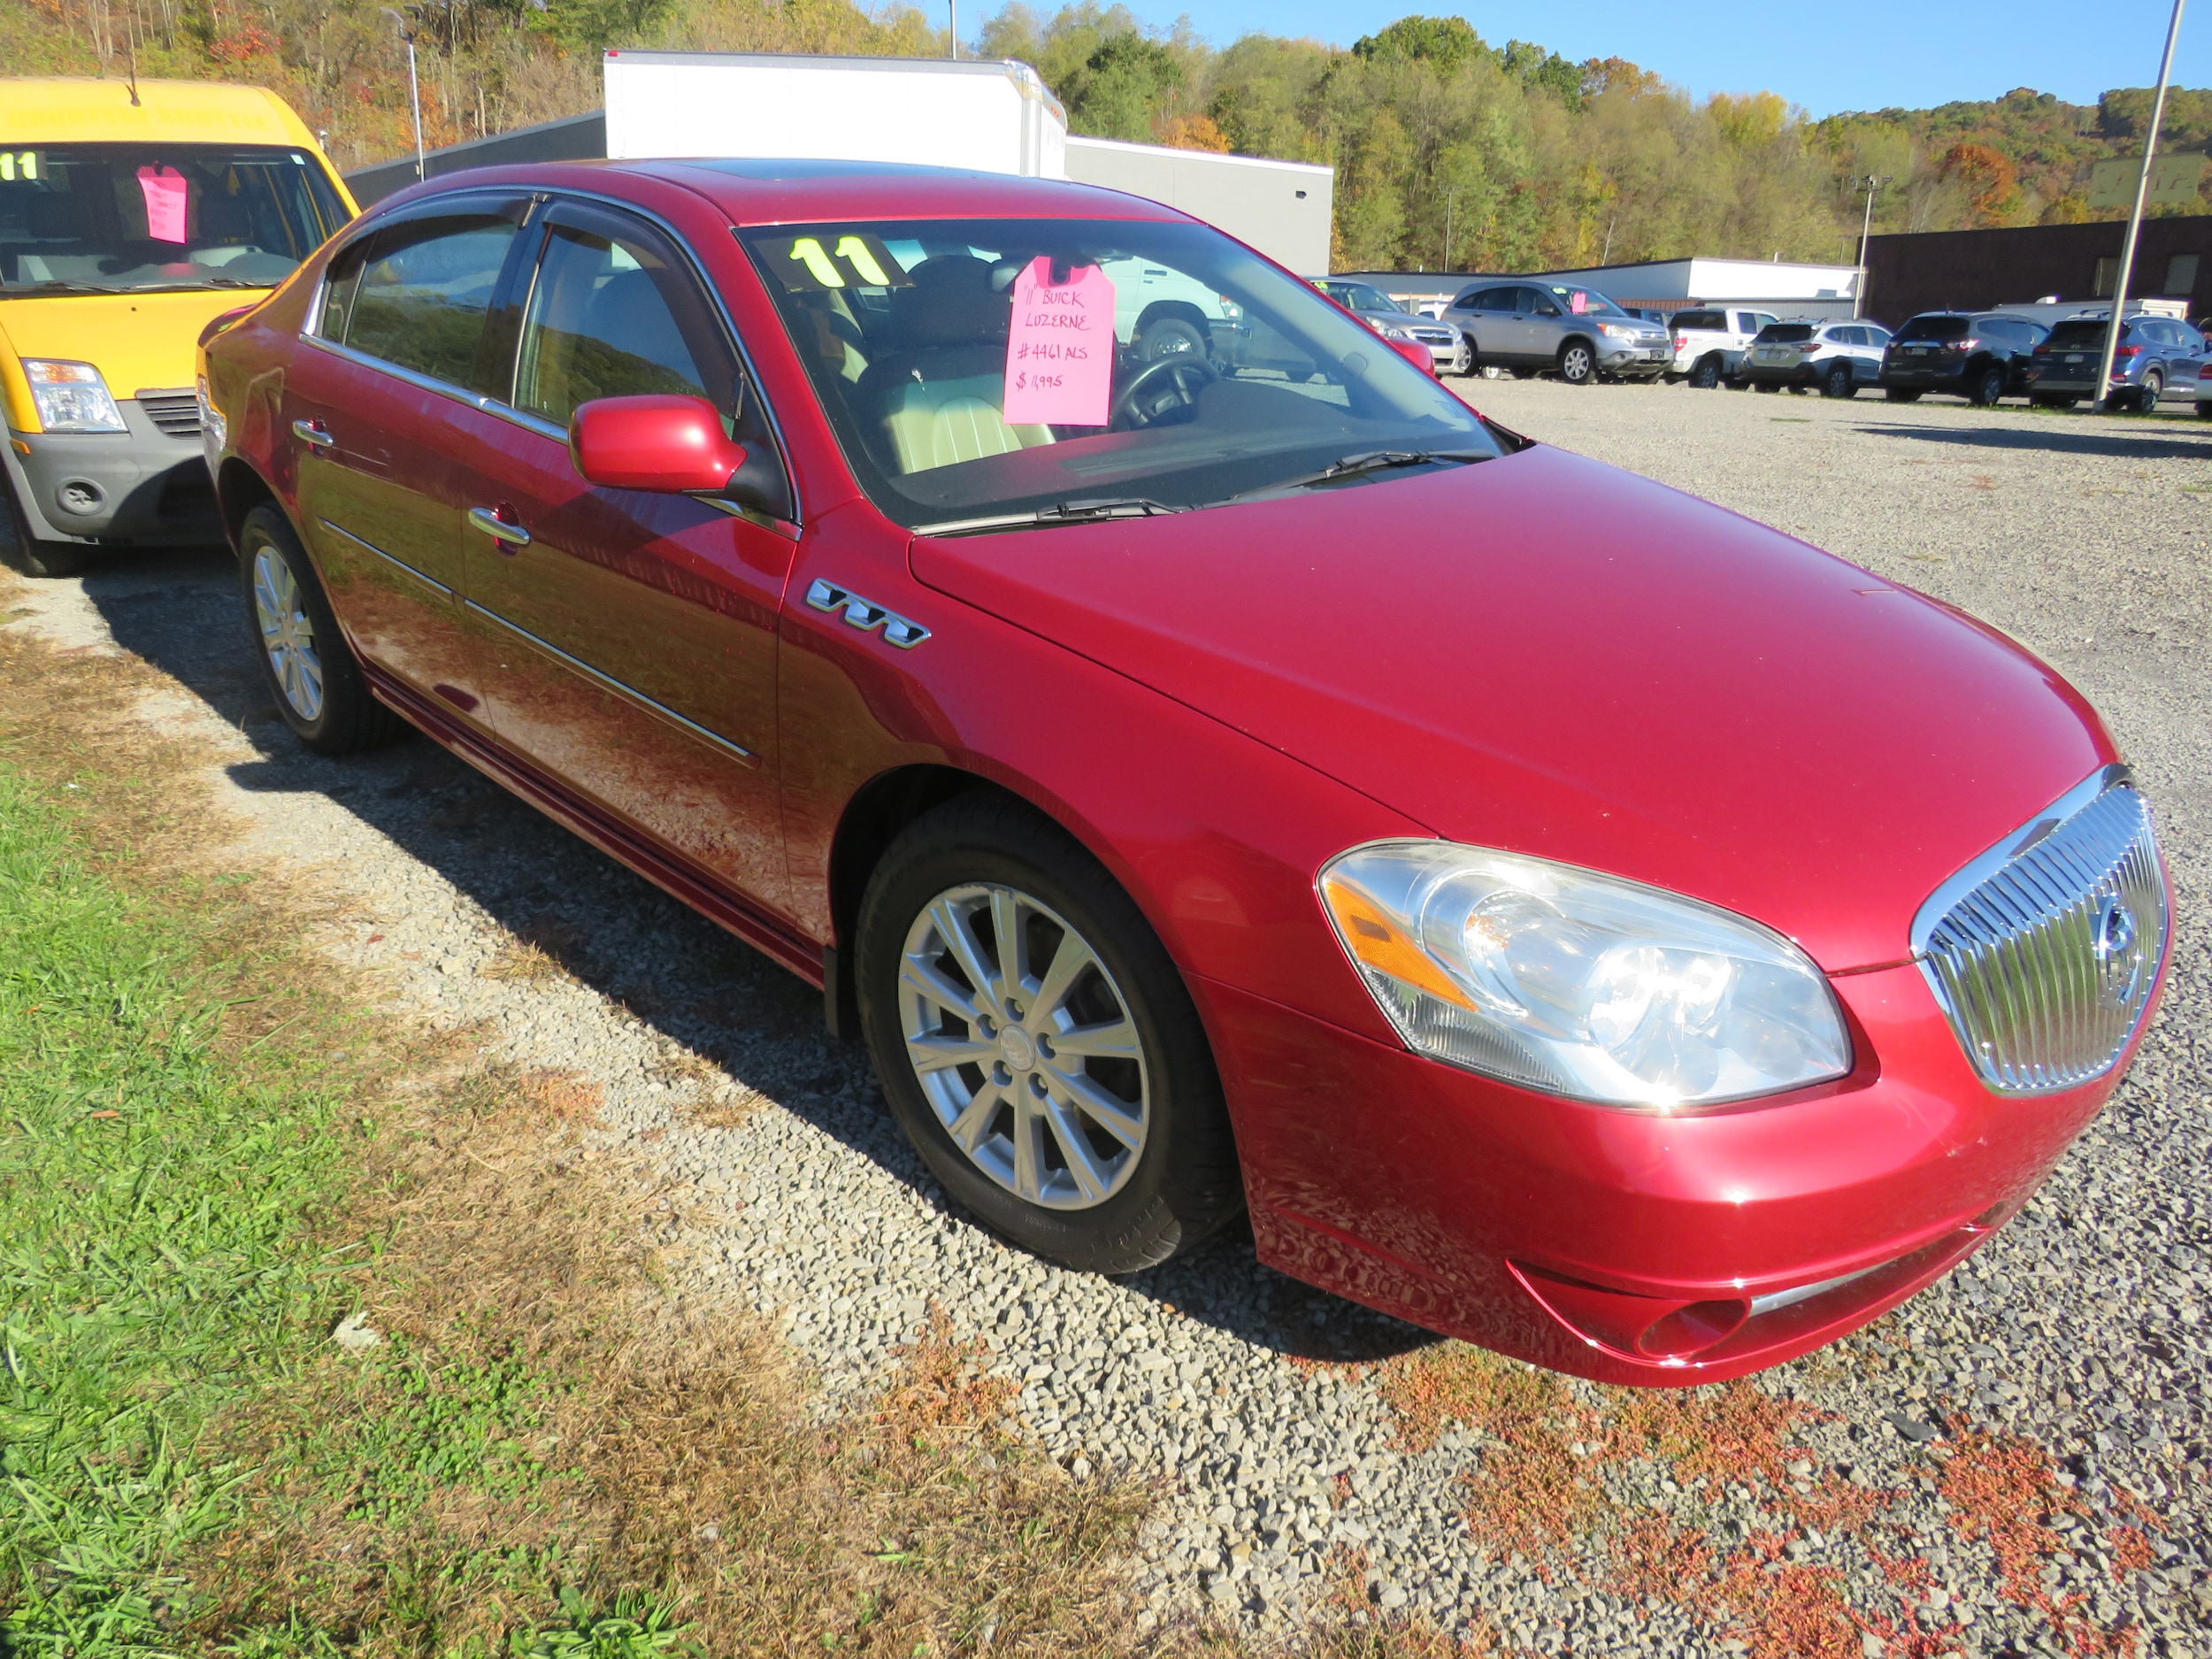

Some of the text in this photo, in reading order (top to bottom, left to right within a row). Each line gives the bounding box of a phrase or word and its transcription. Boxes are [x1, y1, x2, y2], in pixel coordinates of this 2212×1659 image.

[789, 235, 890, 288] 11
[1042, 289, 1085, 309] BUICK
[1025, 312, 1091, 332] LUZERNE
